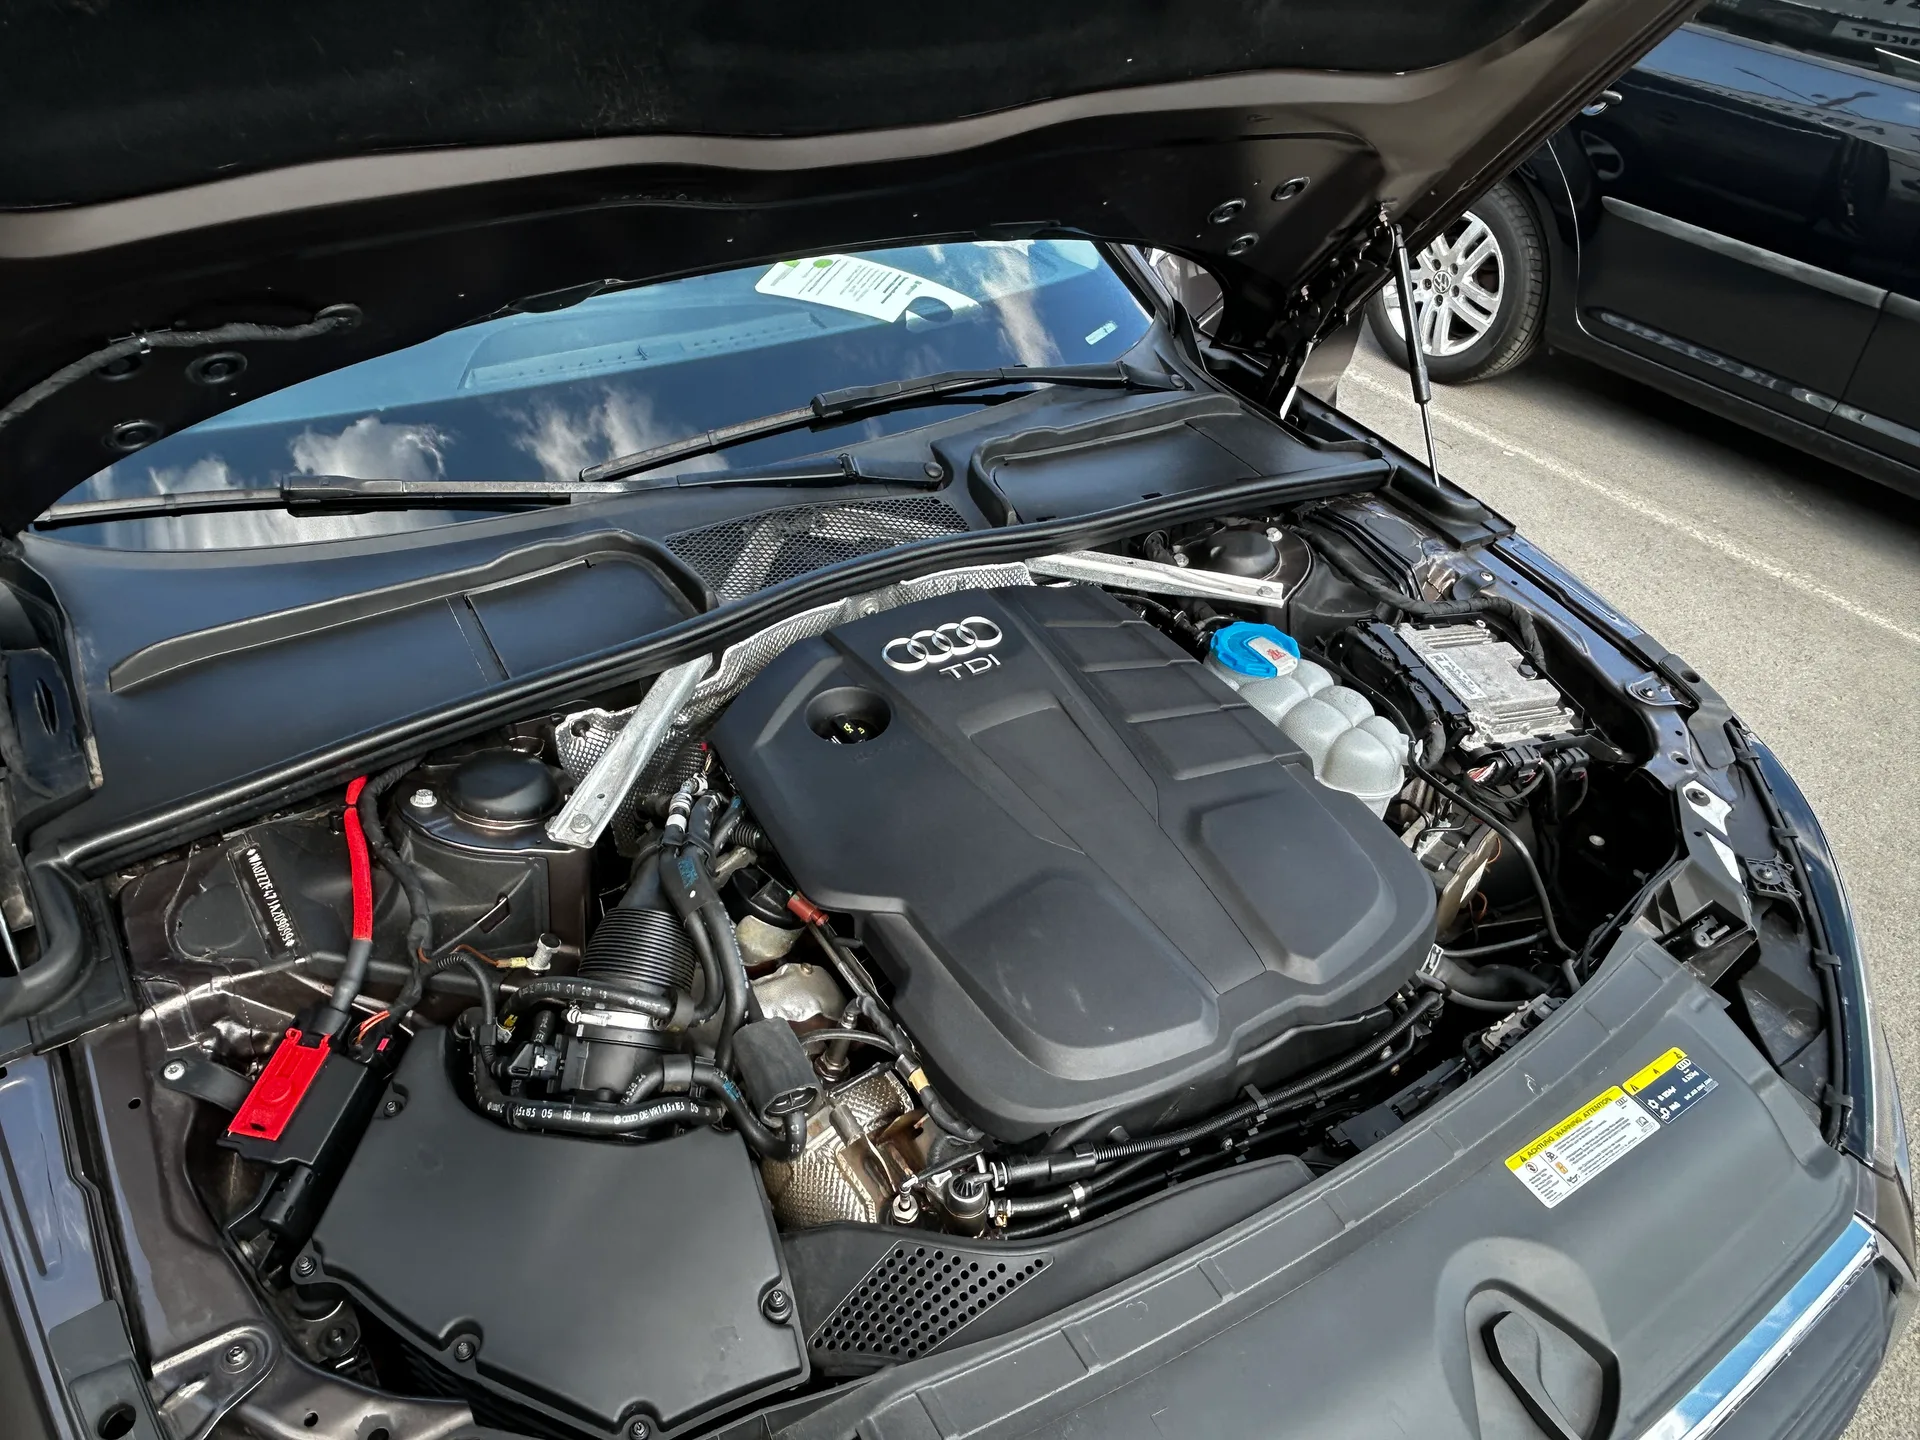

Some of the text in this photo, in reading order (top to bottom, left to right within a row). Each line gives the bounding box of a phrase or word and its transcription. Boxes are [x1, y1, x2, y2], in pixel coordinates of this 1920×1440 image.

[939, 653, 1002, 680] TDI
[1526, 1135, 1555, 1158] ACHTUNG
[1554, 1117, 1583, 1139] WARNING
[1582, 1096, 1613, 1119] ATTENTION
